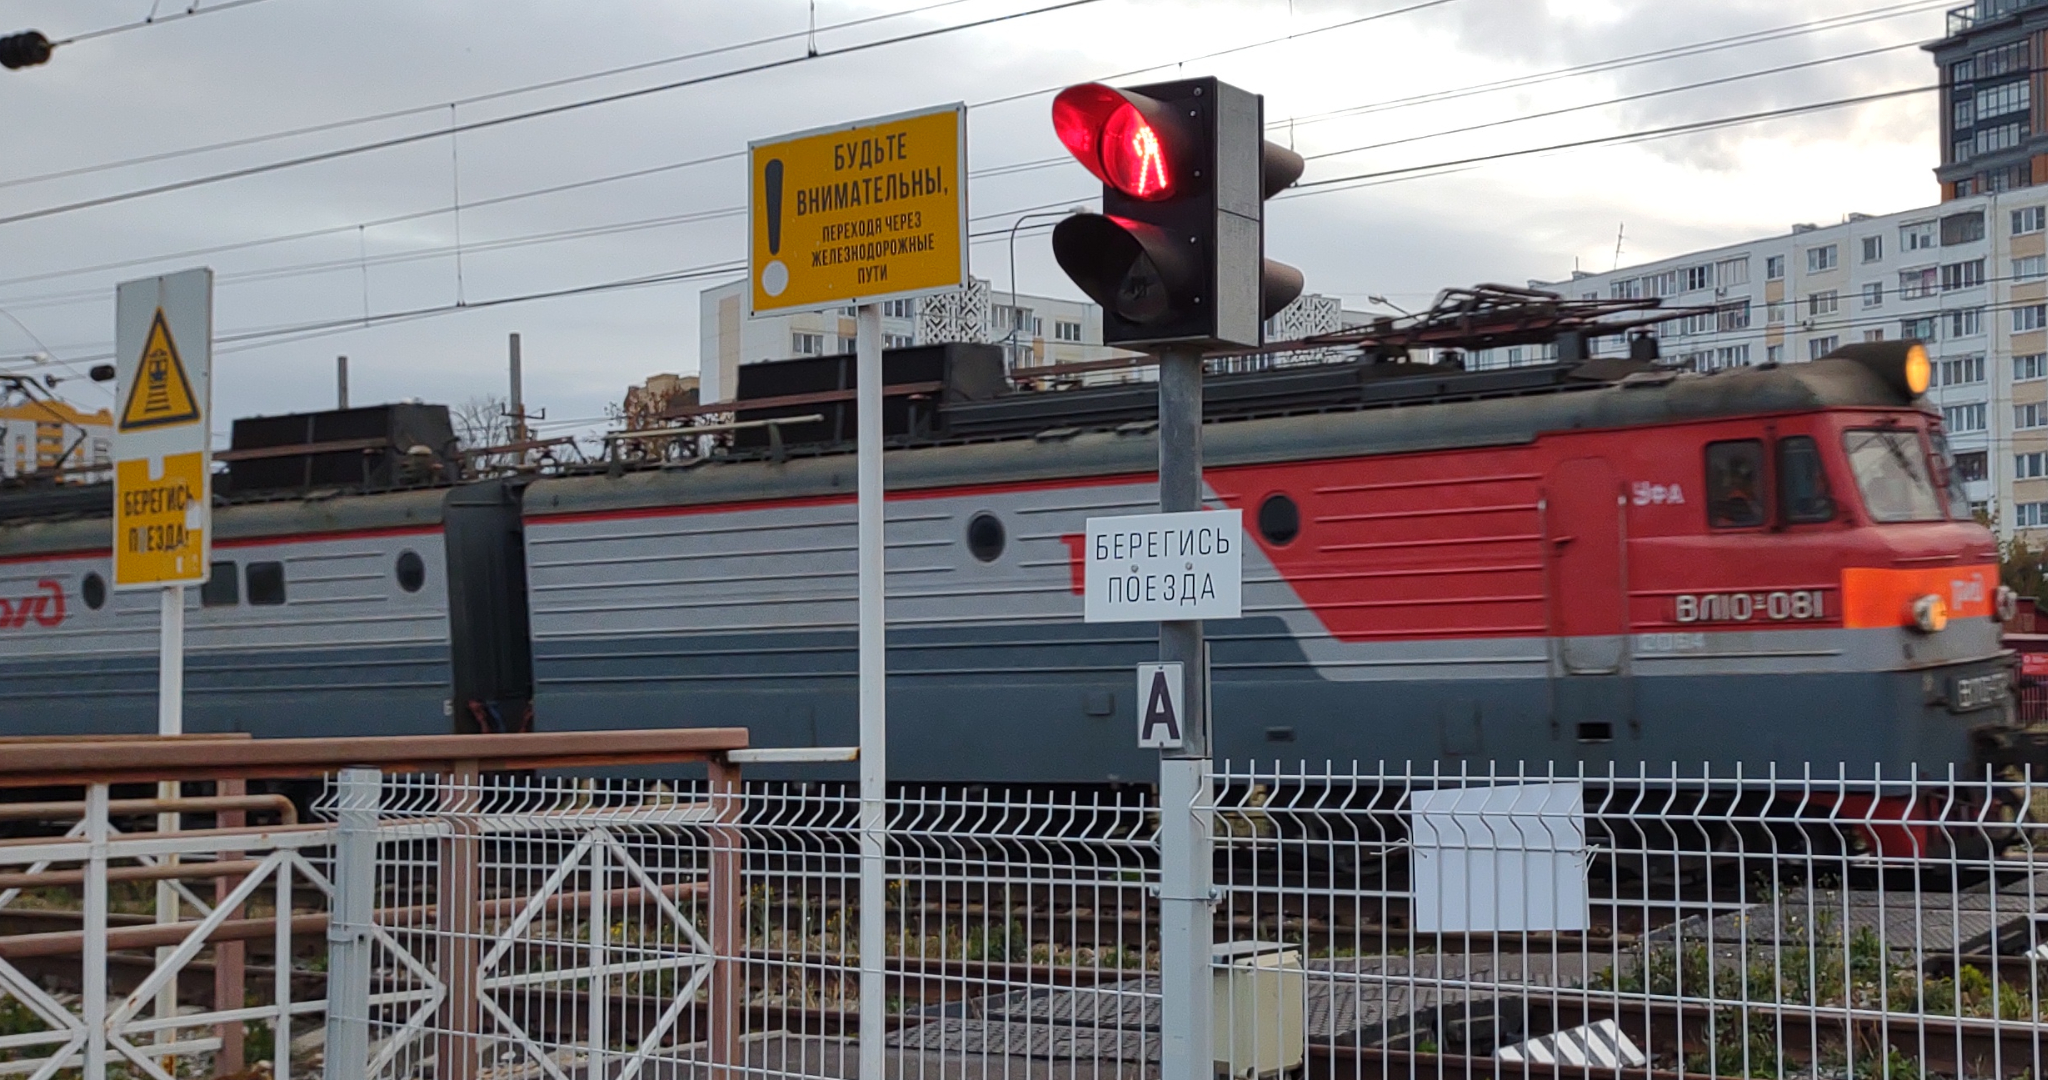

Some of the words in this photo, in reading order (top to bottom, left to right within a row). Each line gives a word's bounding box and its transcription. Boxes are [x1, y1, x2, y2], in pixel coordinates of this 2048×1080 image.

[834, 132, 907, 172] БУДЬТЕ
[797, 166, 948, 216] ВНИМАТЕЛЬНЫ,
[822, 217, 882, 243] ПЕРЕХОДЯ
[885, 211, 922, 233] ЧЕРЕЗ
[811, 233, 935, 268] ЖЕЛЕЗНОДОРОЖНЫЕ
[858, 265, 888, 285] ПУТИ
[1096, 528, 1230, 561] БЕРЕГИСЬ
[1108, 572, 1216, 607] ПОЕЗДА
[1141, 671, 1181, 740] А
